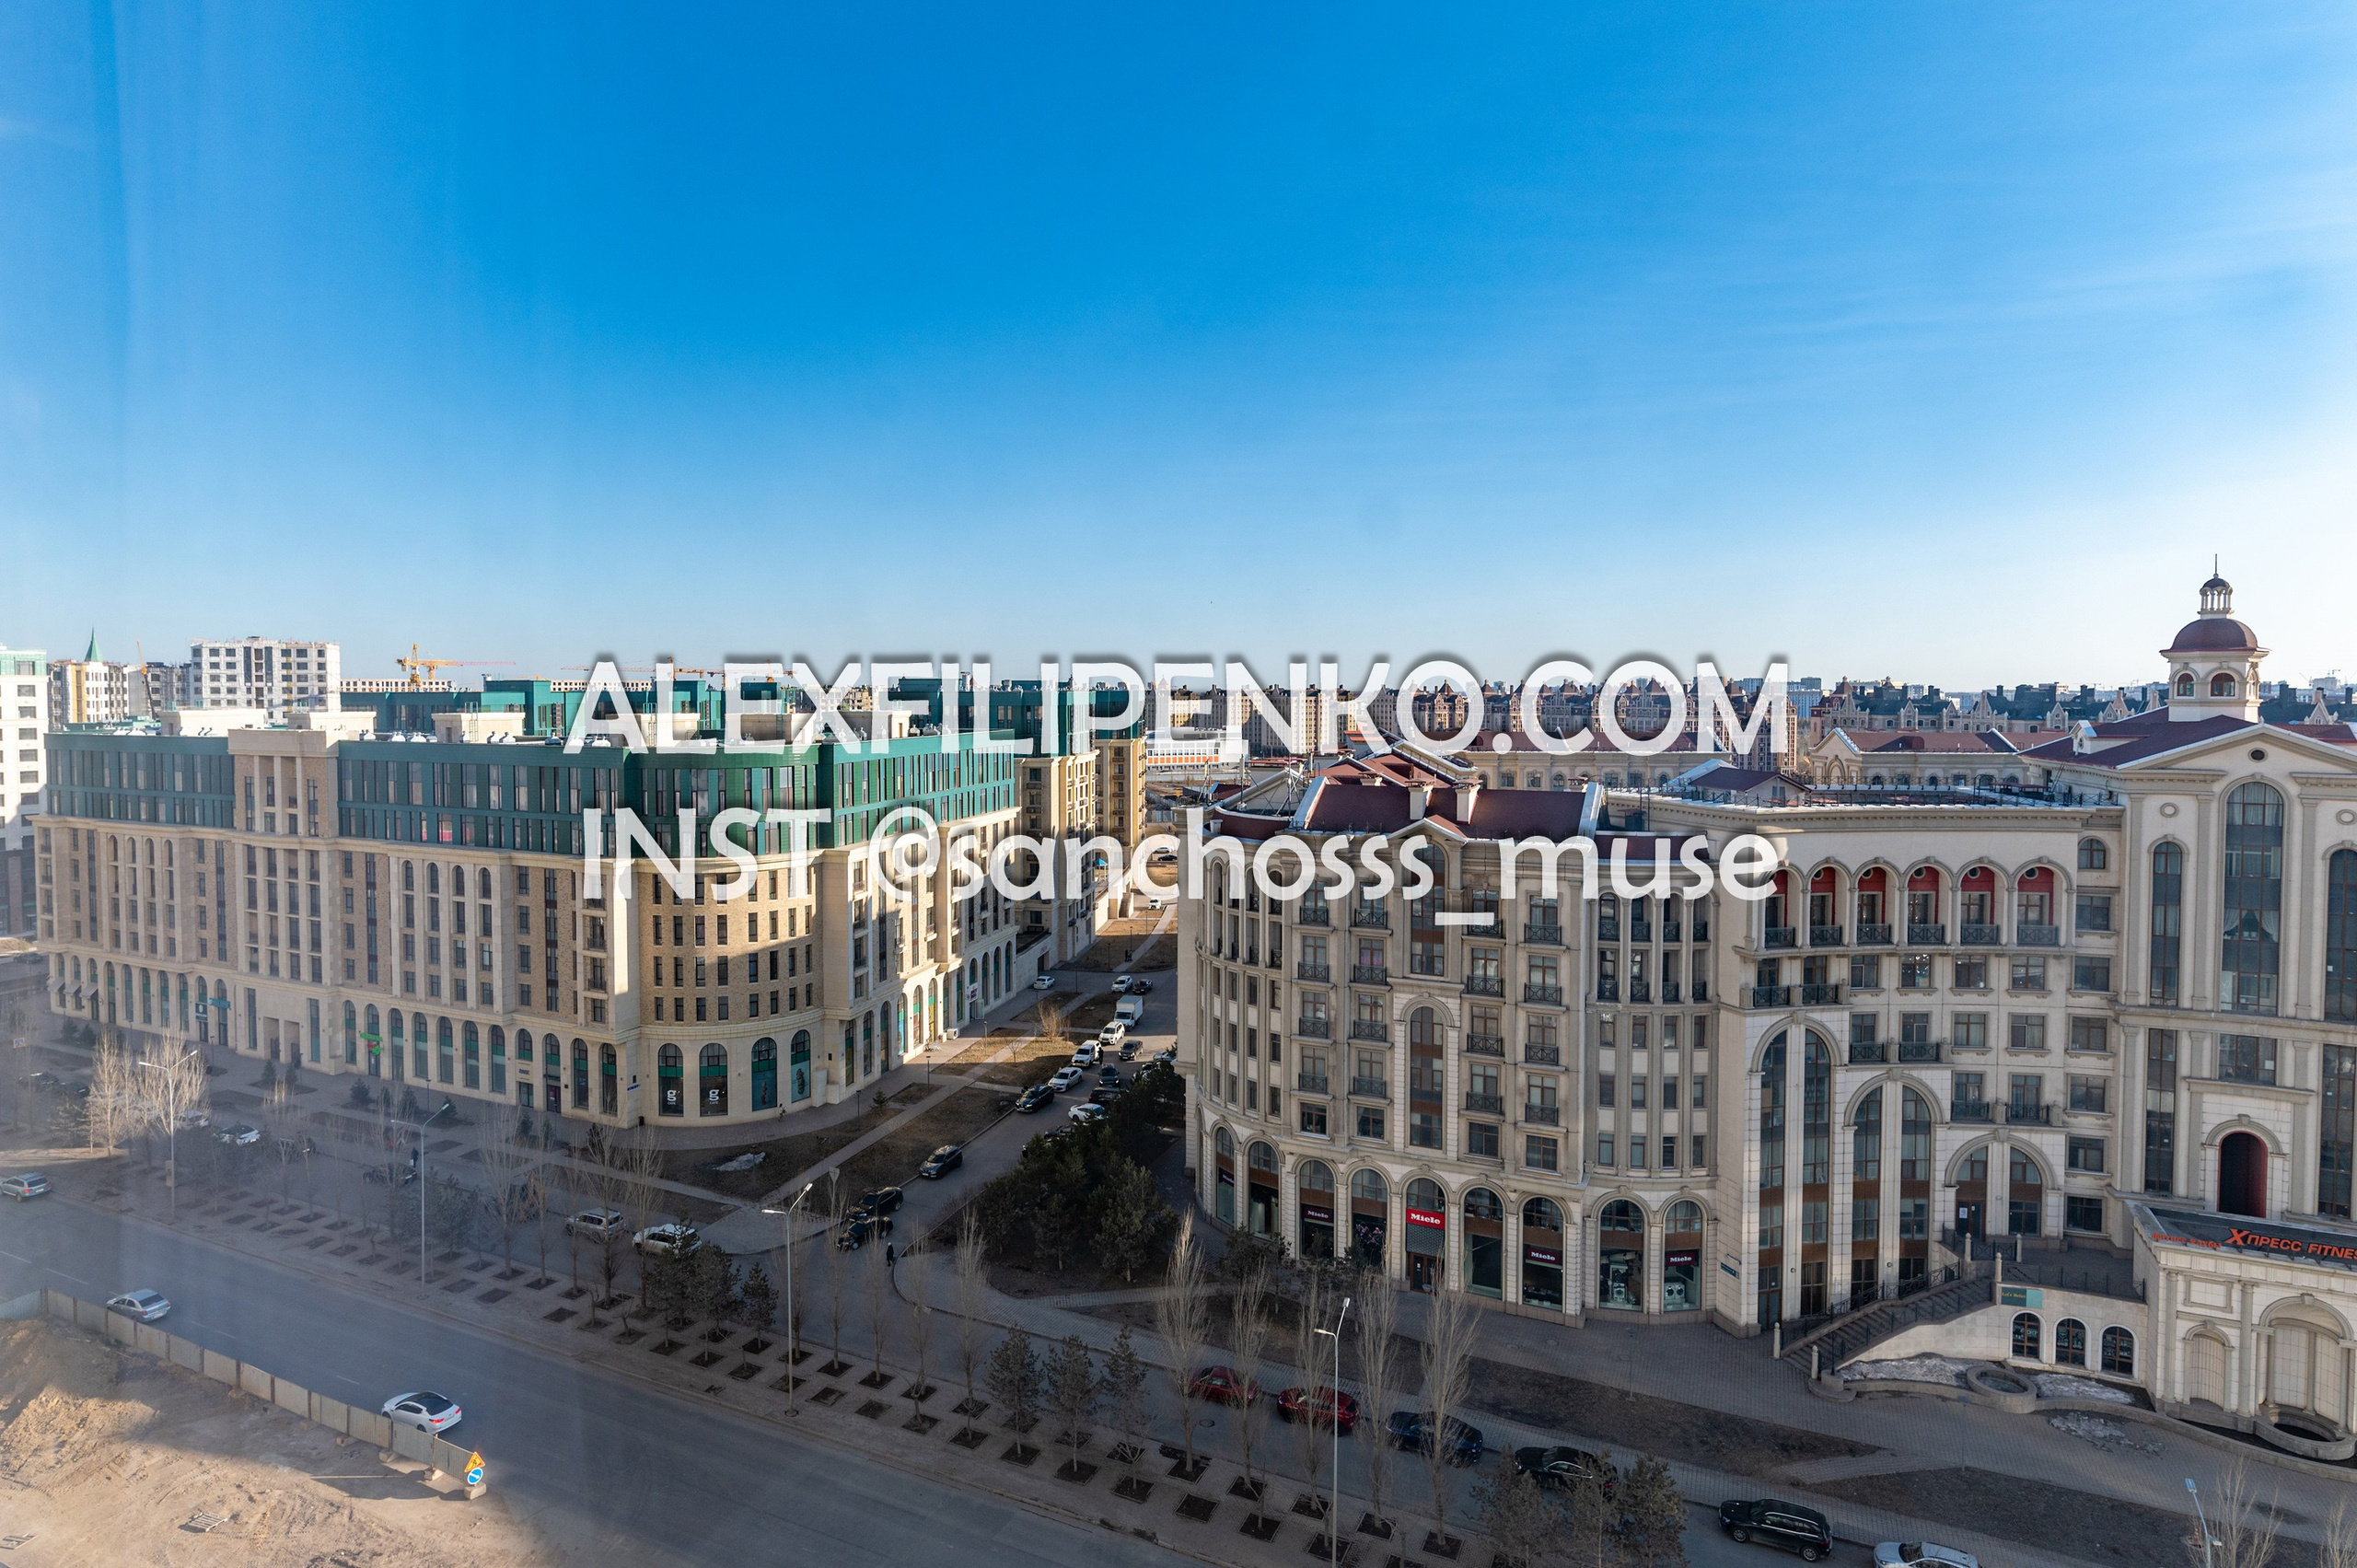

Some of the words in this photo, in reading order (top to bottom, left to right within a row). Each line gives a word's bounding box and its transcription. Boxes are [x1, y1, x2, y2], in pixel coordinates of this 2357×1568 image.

[1307, 1210, 1329, 1219] Miele
[1411, 1213, 1441, 1225] Miele
[1530, 1251, 1556, 1260] Miele
